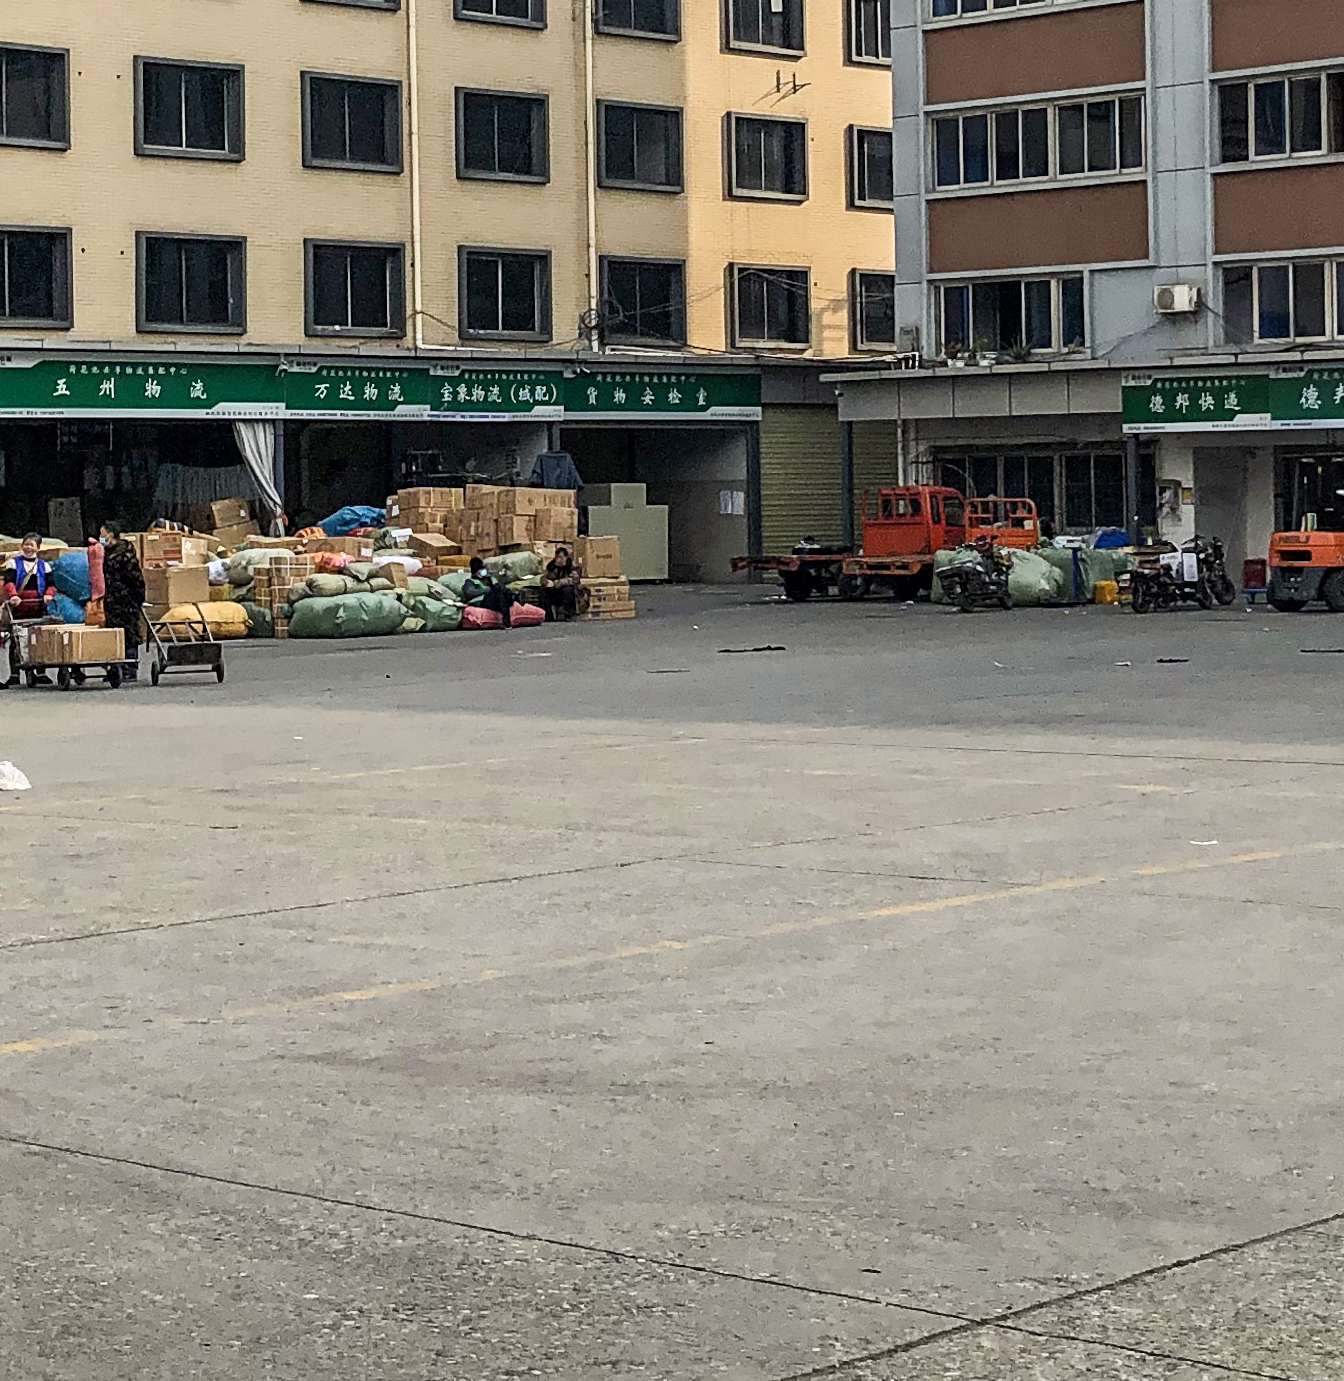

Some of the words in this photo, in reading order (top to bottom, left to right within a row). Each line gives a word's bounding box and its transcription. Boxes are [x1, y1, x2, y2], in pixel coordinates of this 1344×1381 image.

[53, 377, 207, 399] 五州物流
[314, 381, 404, 402] 万达物流
[1149, 390, 1242, 414] 德邦快递
